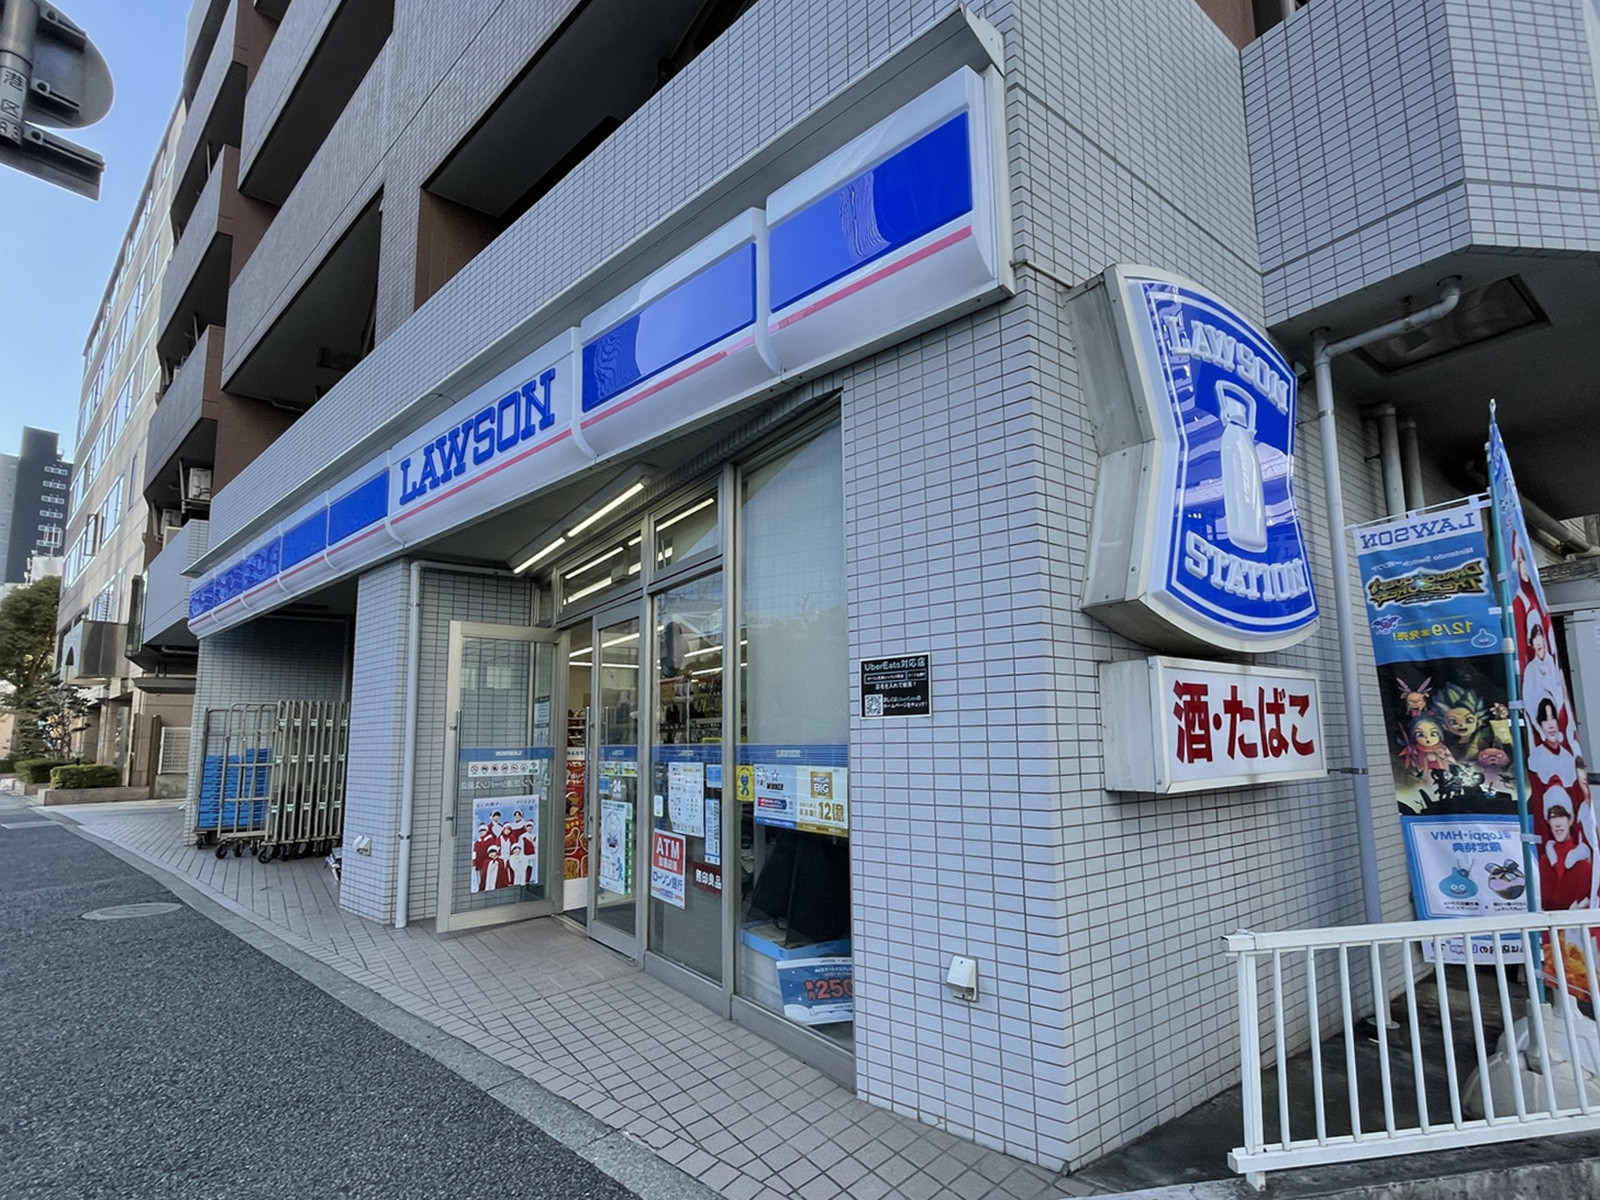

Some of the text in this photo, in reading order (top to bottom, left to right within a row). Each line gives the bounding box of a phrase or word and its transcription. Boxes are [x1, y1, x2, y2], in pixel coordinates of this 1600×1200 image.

[1, 70, 24, 118] 港区
[1162, 315, 1290, 415] LAWSON
[399, 367, 556, 506] LAWSON
[1185, 531, 1309, 602] STATION
[1172, 679, 1315, 764] 酒・たばこ
[656, 837, 680, 860] ATM
[695, 868, 722, 890] 無印良品
